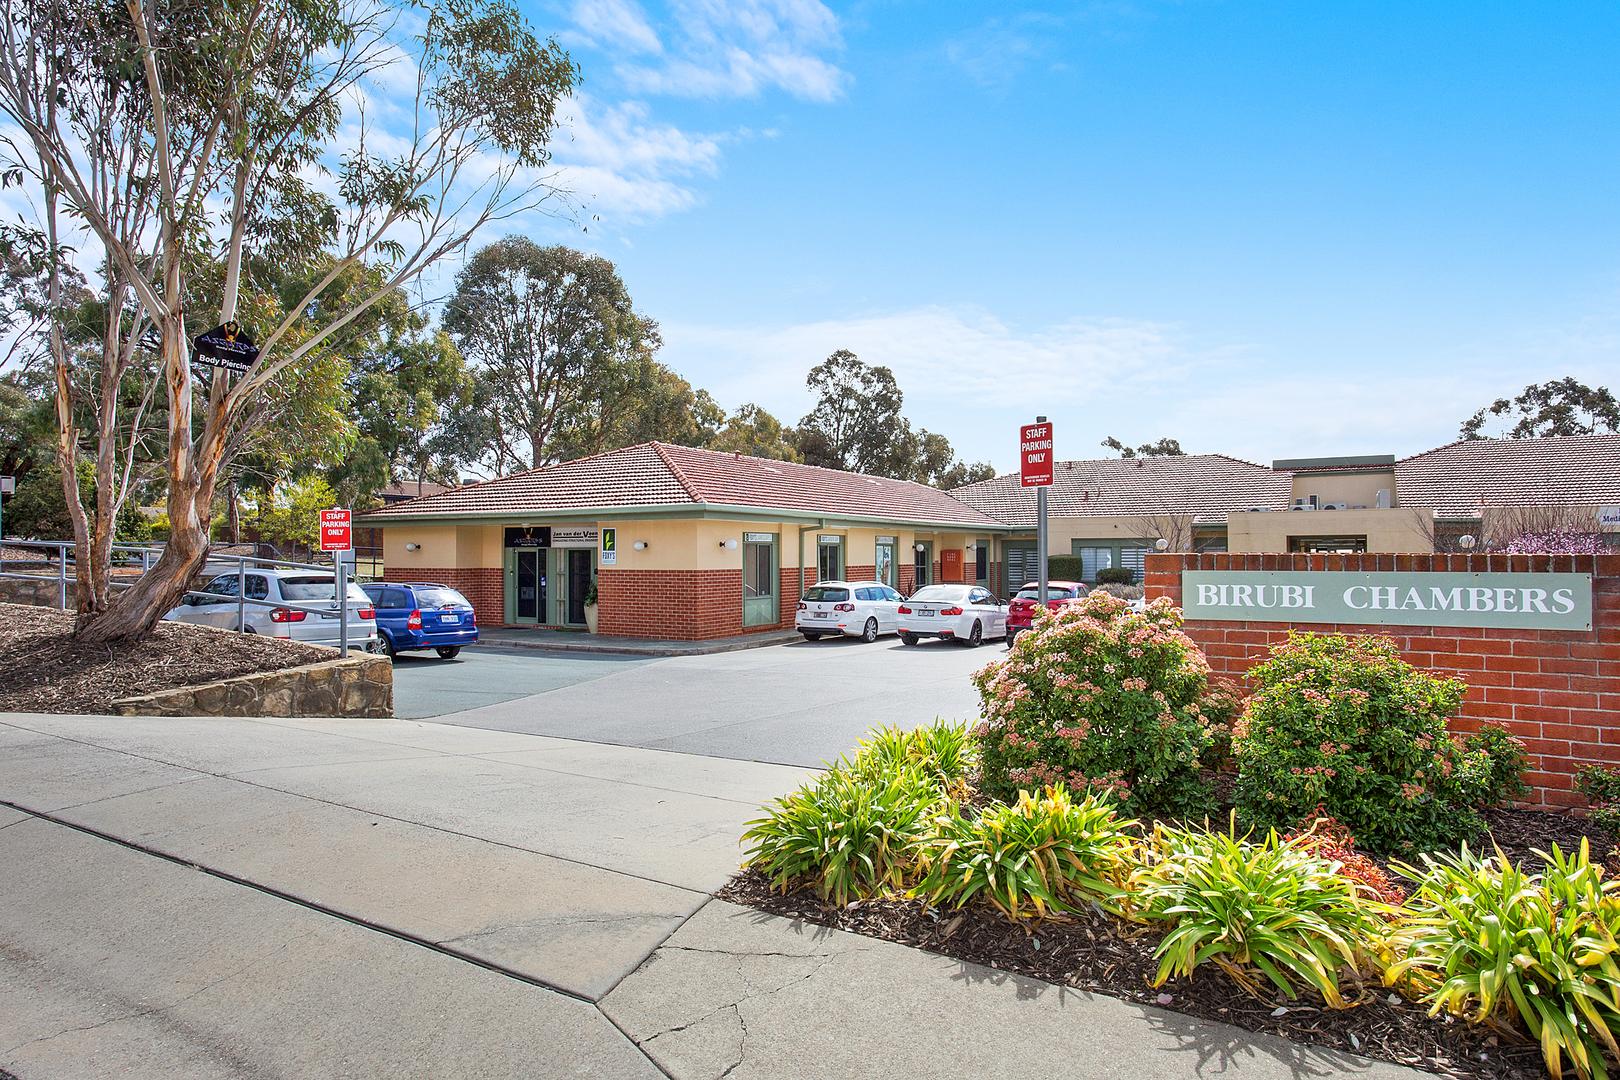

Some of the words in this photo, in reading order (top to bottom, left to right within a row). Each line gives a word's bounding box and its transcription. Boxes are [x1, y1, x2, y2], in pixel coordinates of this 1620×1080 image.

[199, 354, 220, 366] Body
[222, 358, 252, 371] Piercing
[1026, 428, 1047, 439] STAFF
[1022, 440, 1051, 452] PARKING
[1028, 453, 1045, 464] ONLY
[1196, 584, 1316, 608] BIRUBI
[1342, 585, 1575, 614] CHAMBERS
